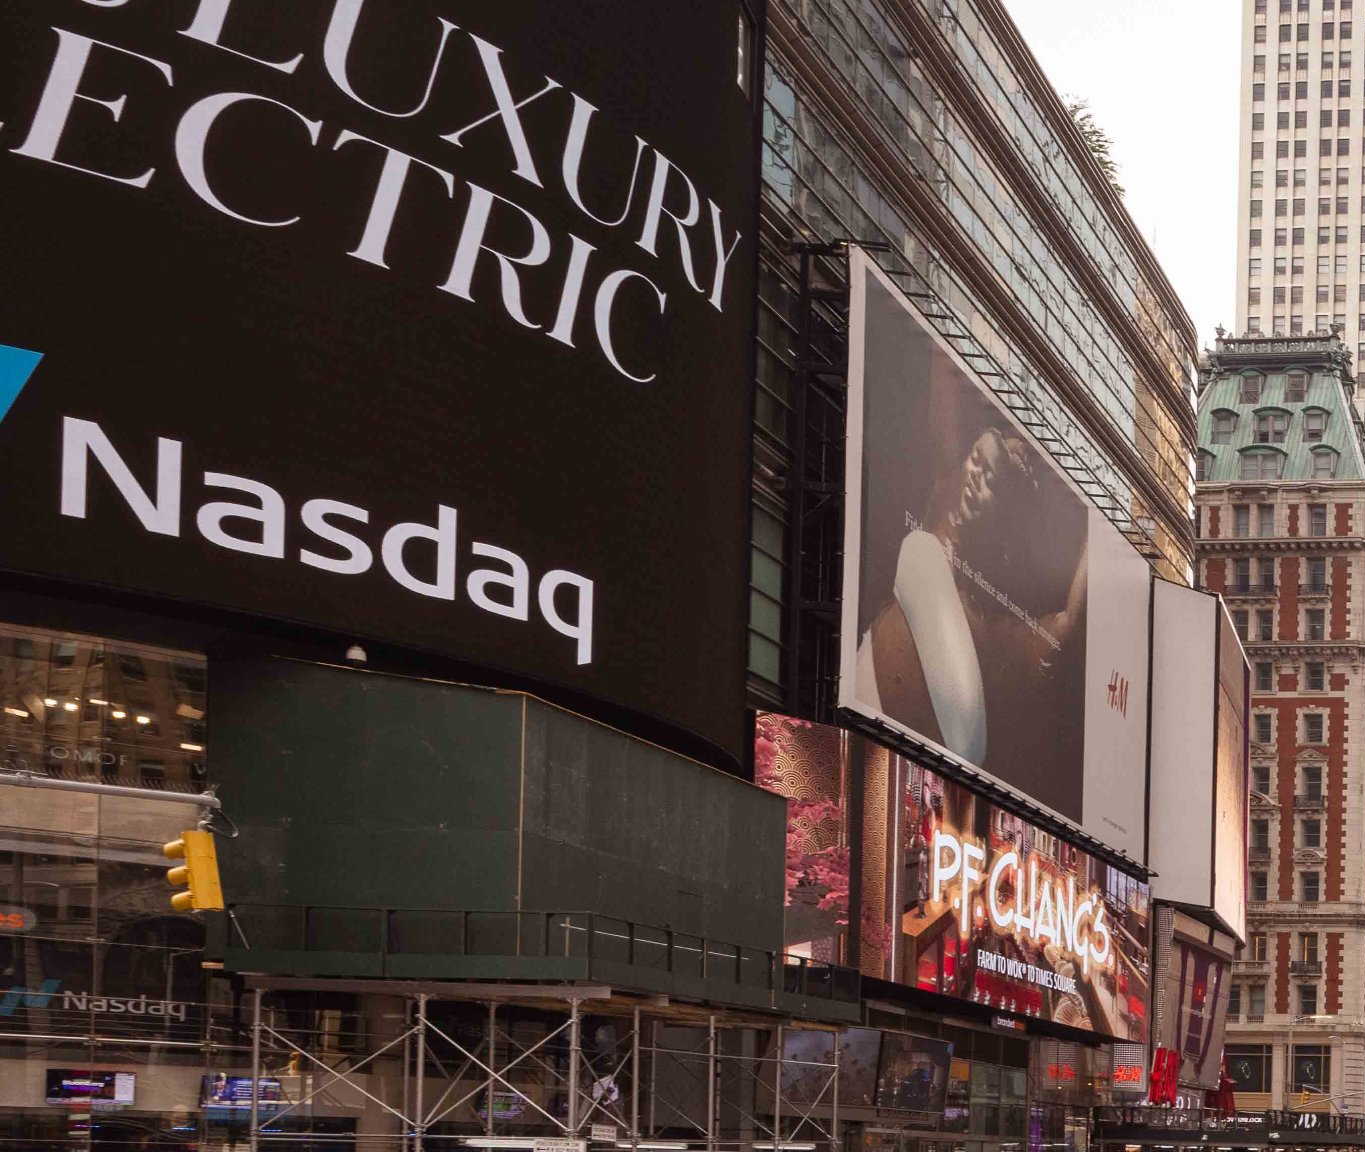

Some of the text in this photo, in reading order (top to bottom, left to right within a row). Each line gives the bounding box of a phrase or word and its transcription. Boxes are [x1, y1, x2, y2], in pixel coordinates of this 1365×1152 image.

[0, 27, 668, 383] ECTRIC
[62, 416, 594, 665] Nasdaq
[63, 990, 186, 1021] Nasdaq
[977, 949, 996, 969] FARM
[996, 955, 1006, 973] TO
[1026, 965, 1035, 984] TO
[1035, 967, 1053, 989] TIMES
[1053, 973, 1076, 995] SQUARE
